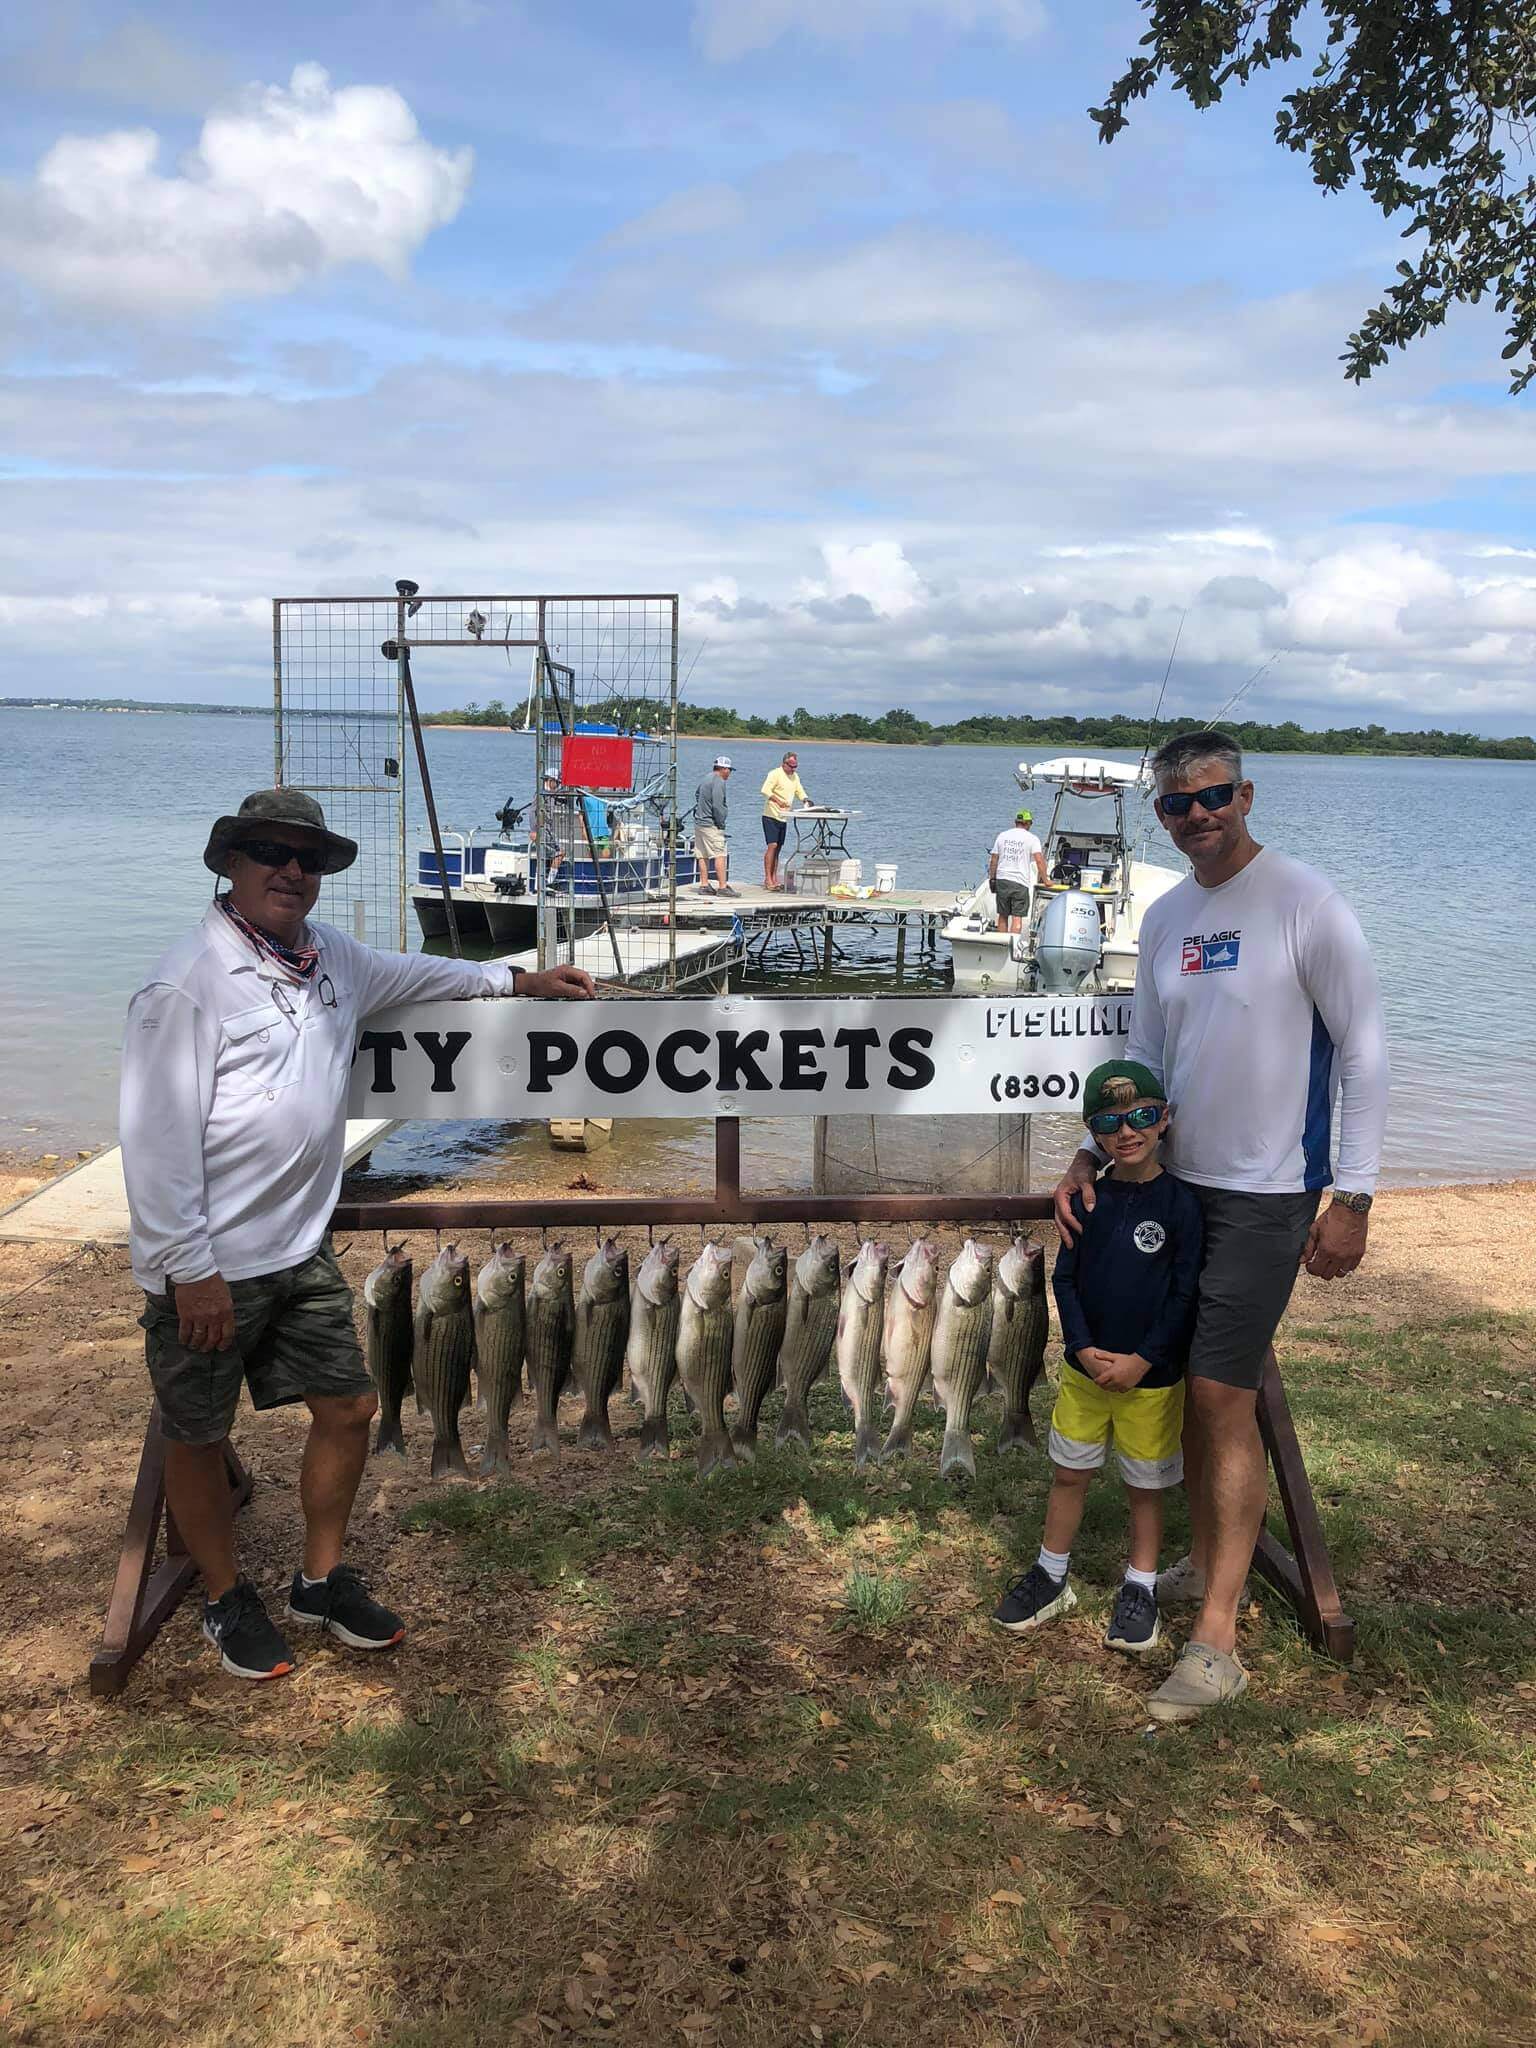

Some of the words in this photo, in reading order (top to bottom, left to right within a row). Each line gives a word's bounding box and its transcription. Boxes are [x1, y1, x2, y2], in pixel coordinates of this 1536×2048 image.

[1183, 930, 1241, 946] PELAGIC
[351, 1030, 472, 1092] TY
[526, 1028, 935, 1093] POCKETS
[990, 1071, 1080, 1102] (830)
